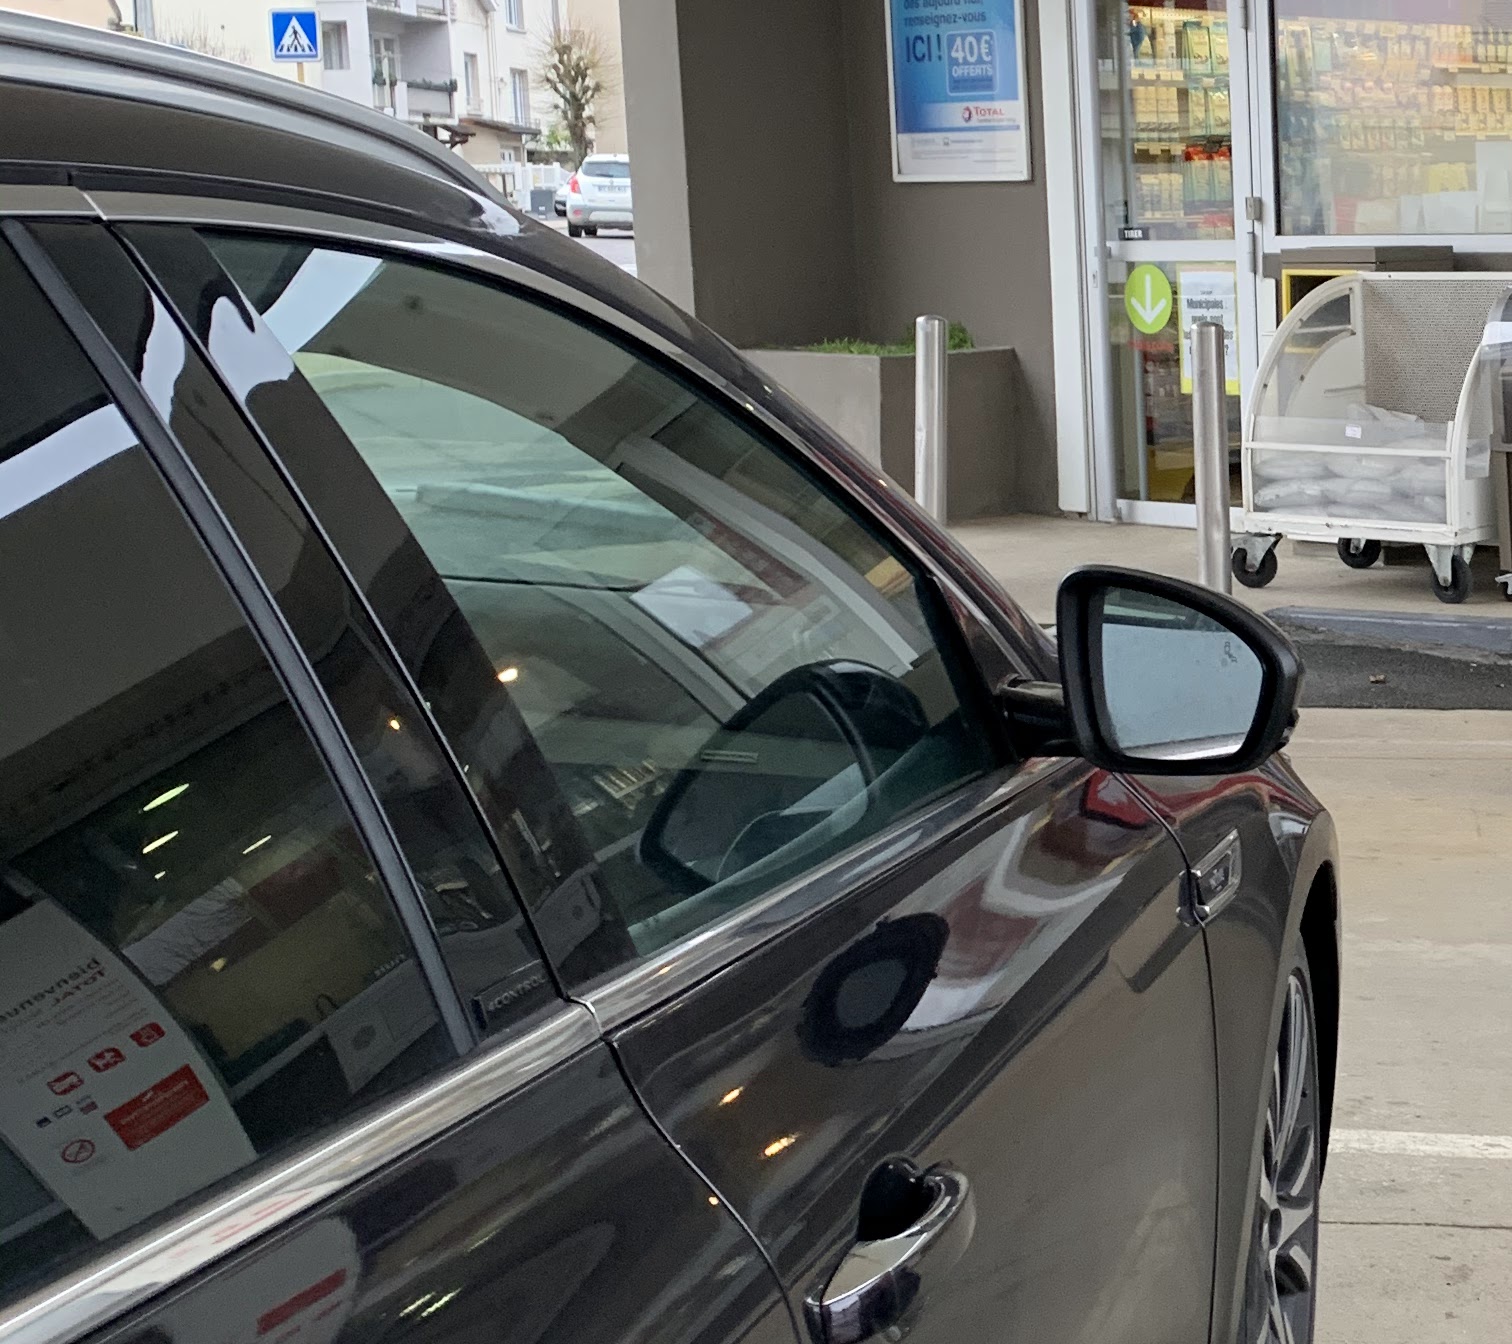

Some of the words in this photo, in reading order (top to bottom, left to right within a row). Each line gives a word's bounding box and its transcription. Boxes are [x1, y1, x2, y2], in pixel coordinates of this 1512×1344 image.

[952, 65, 993, 78] OFFERTS
[973, 106, 1005, 117] TOTAL
[1124, 229, 1143, 239] TIRER
